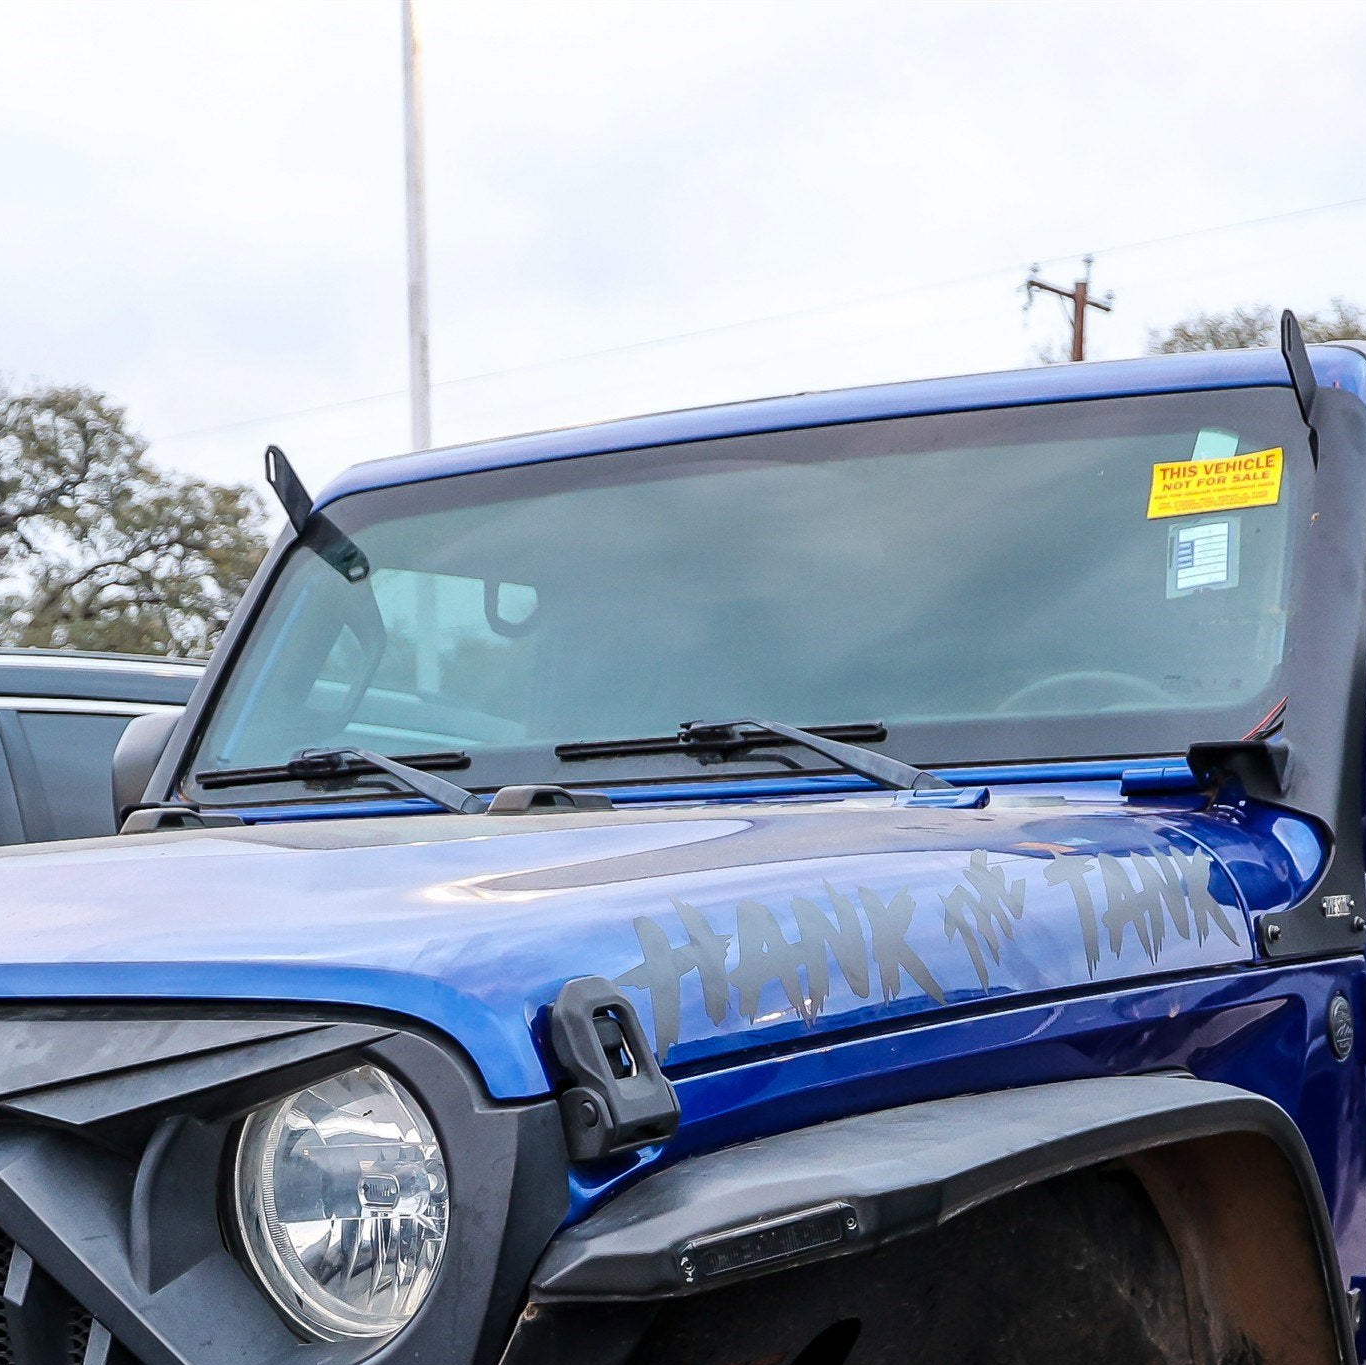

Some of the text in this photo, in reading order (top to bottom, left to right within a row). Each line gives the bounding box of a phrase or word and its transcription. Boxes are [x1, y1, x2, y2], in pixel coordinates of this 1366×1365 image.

[1160, 454, 1275, 480] THIS VEHICLE
[1162, 480, 1190, 491] NOT
[1196, 476, 1227, 487] FOR
[1232, 470, 1271, 483] SALE
[612, 879, 947, 1063] HANK
[1043, 845, 1240, 980] TANK
